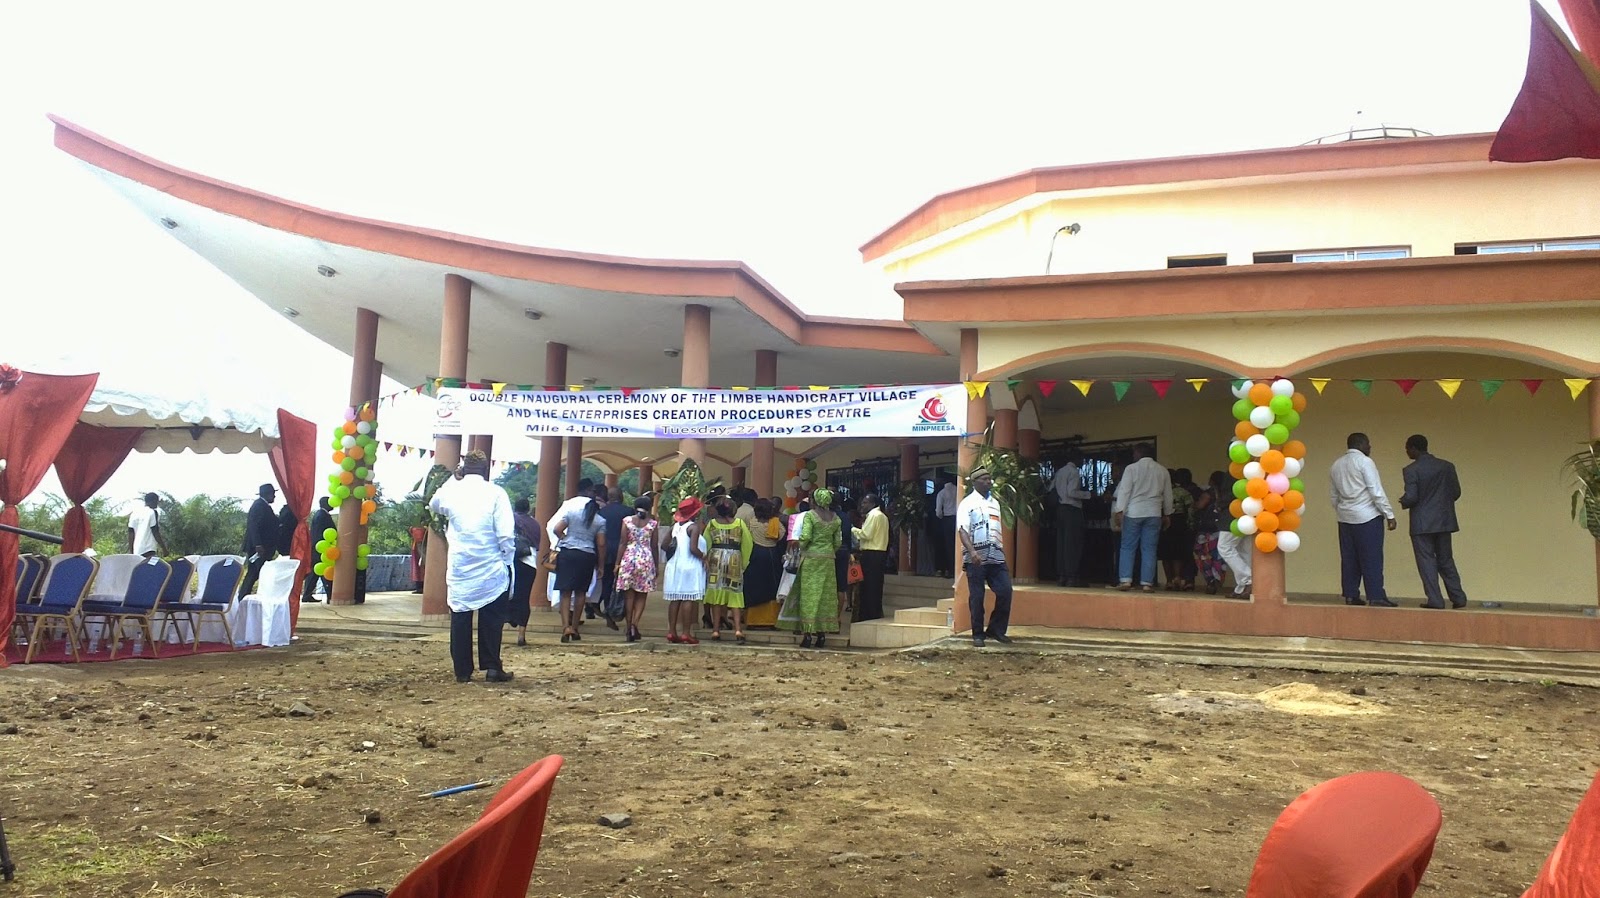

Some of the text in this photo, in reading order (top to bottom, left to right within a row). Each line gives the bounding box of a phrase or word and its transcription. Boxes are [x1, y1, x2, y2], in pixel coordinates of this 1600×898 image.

[470, 390, 917, 404] DOUBLE INAUGURAL CEREMONY OF THE LIMBE HANDICRAFT VILLAGE
[507, 407, 871, 420] AND THE ENTERPRISES CREATION PROCEDURES CENTRE
[526, 424, 560, 433] Mile
[661, 425, 731, 435] Tuesday,
[737, 425, 755, 434] 27
[760, 425, 795, 435] May
[801, 424, 847, 433] 2014
